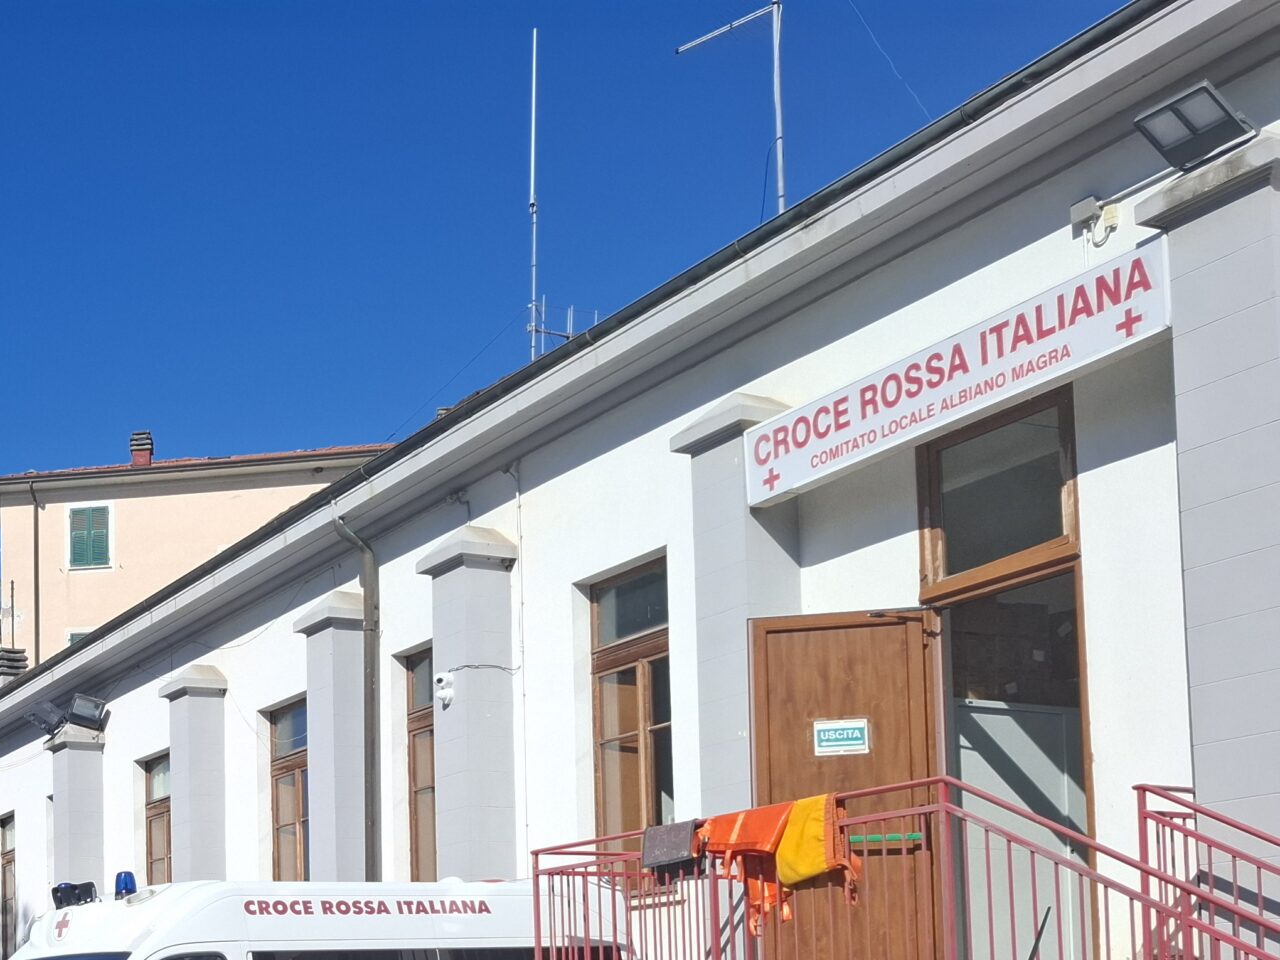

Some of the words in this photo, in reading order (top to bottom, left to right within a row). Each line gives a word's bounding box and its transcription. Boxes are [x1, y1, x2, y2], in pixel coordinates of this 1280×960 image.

[754, 395, 851, 466] CROCE
[859, 342, 970, 420] ROSSA
[979, 256, 1152, 366] ITALIANA
[810, 429, 878, 469] COMITATO
[881, 402, 936, 439] LOCALE
[940, 372, 1007, 415] ALBIANO
[1011, 343, 1072, 382] MAGRA
[820, 729, 862, 740] USCITA
[243, 899, 315, 916] CROCE
[320, 899, 392, 915] ROSSA
[396, 899, 493, 915] ITALIANA
